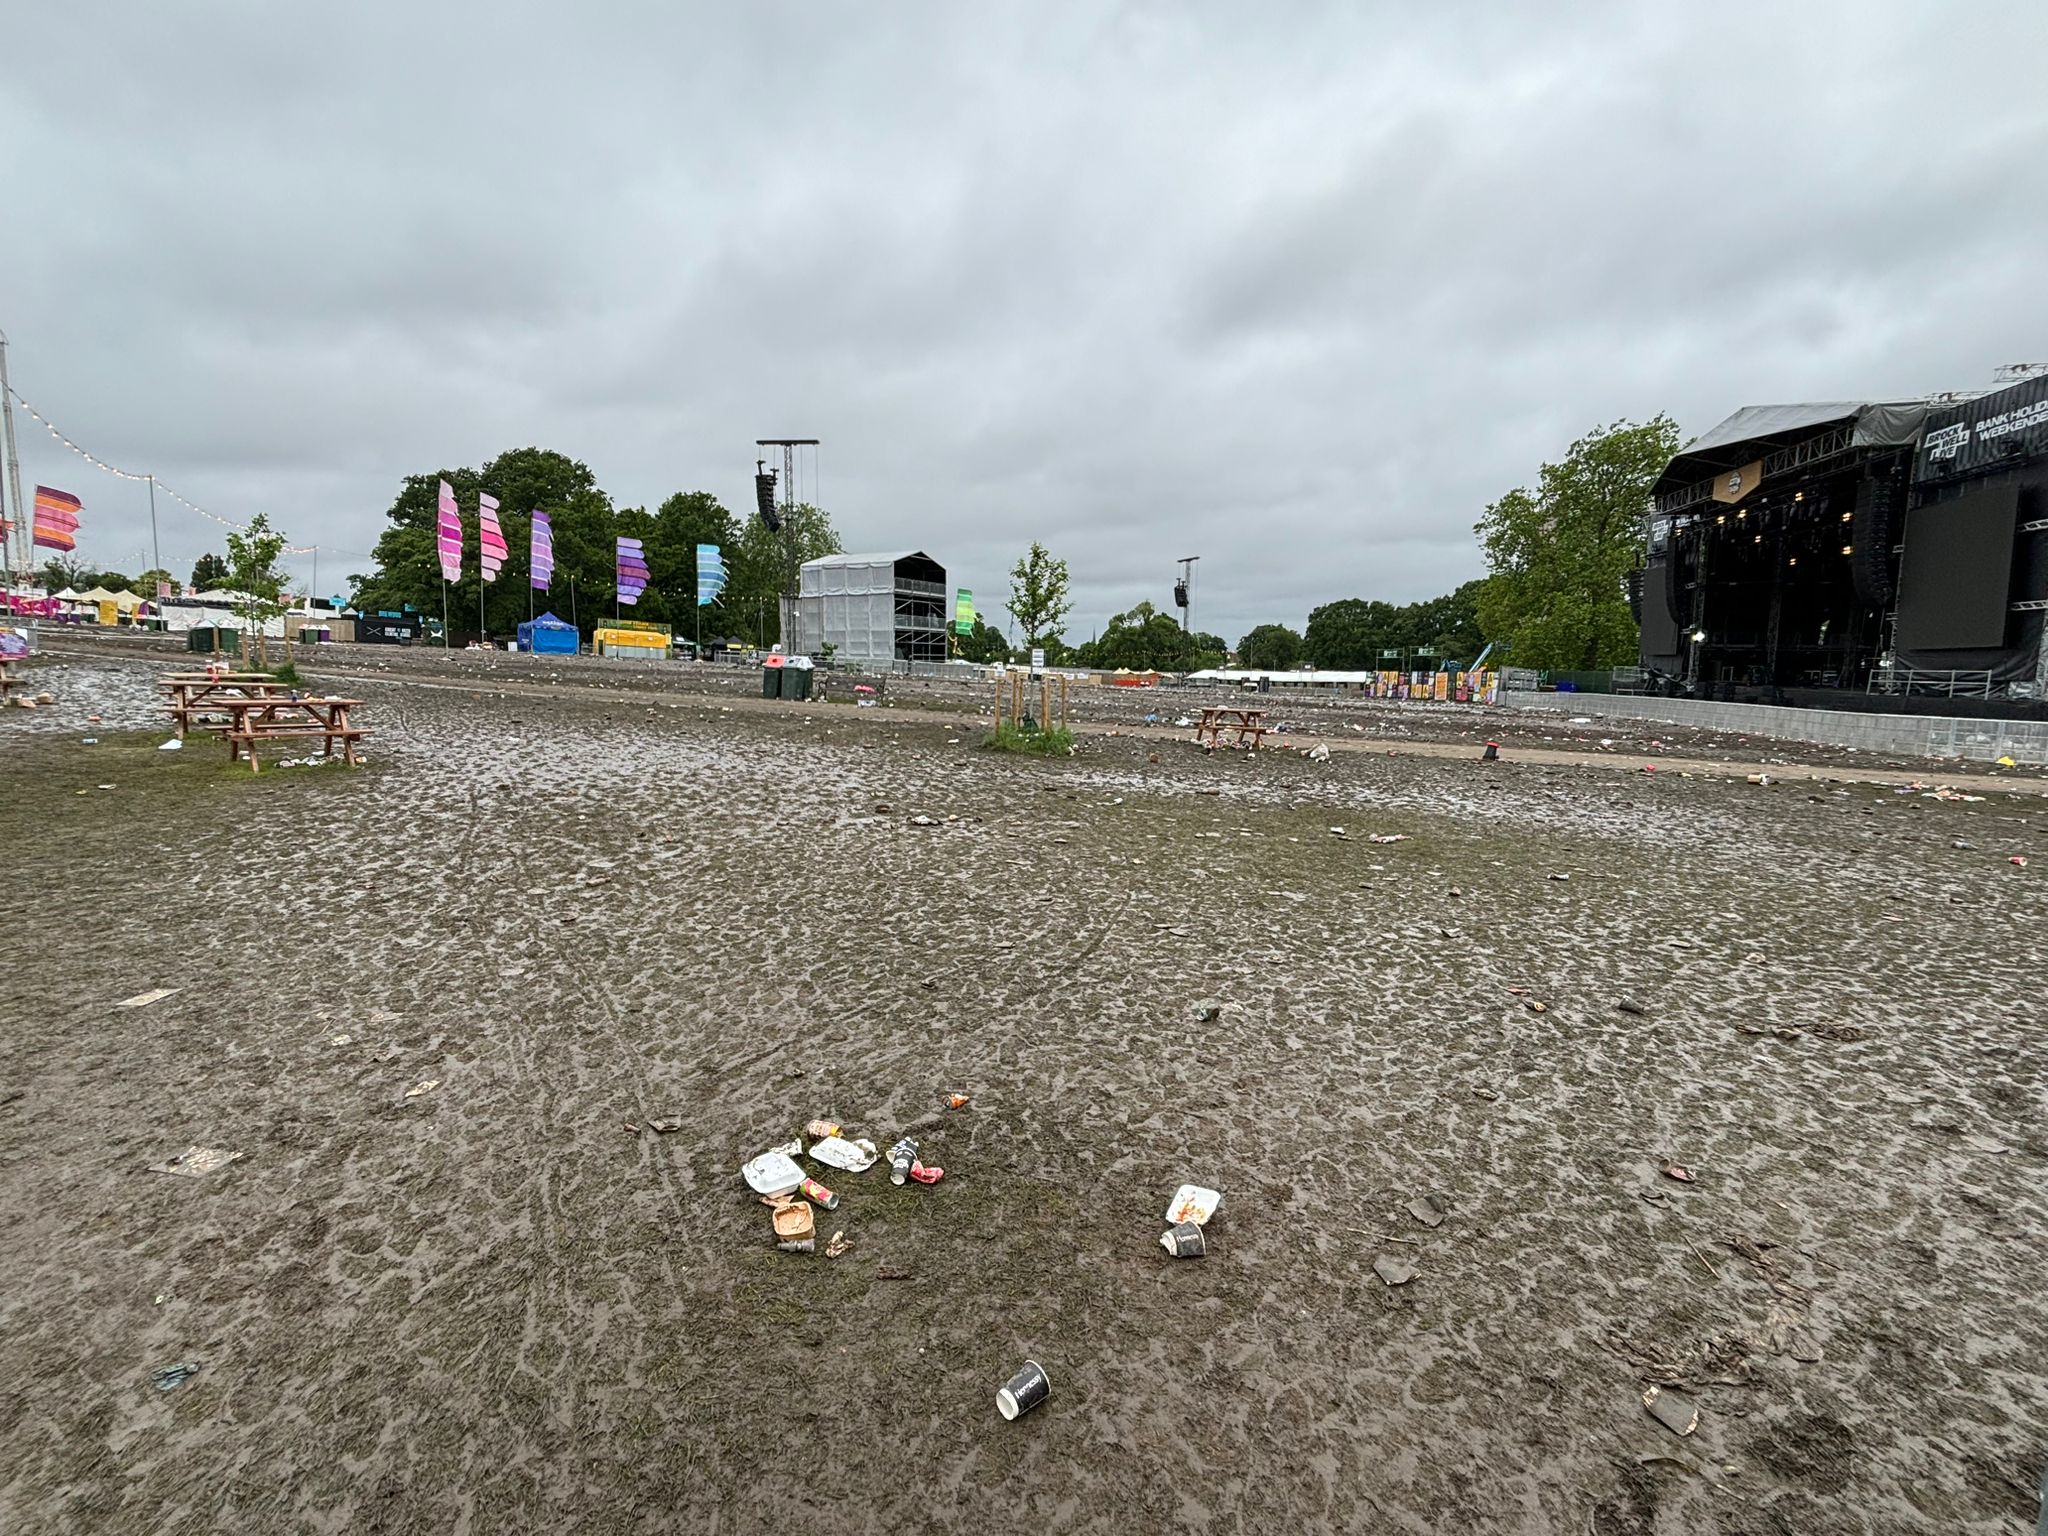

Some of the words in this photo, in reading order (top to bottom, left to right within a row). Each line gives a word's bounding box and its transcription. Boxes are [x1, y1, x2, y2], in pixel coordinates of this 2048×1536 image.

[1975, 413, 2009, 432] BANK
[2009, 400, 2048, 421] HOLID
[1926, 424, 1963, 446] BROCK
[1941, 431, 1968, 449] WELL
